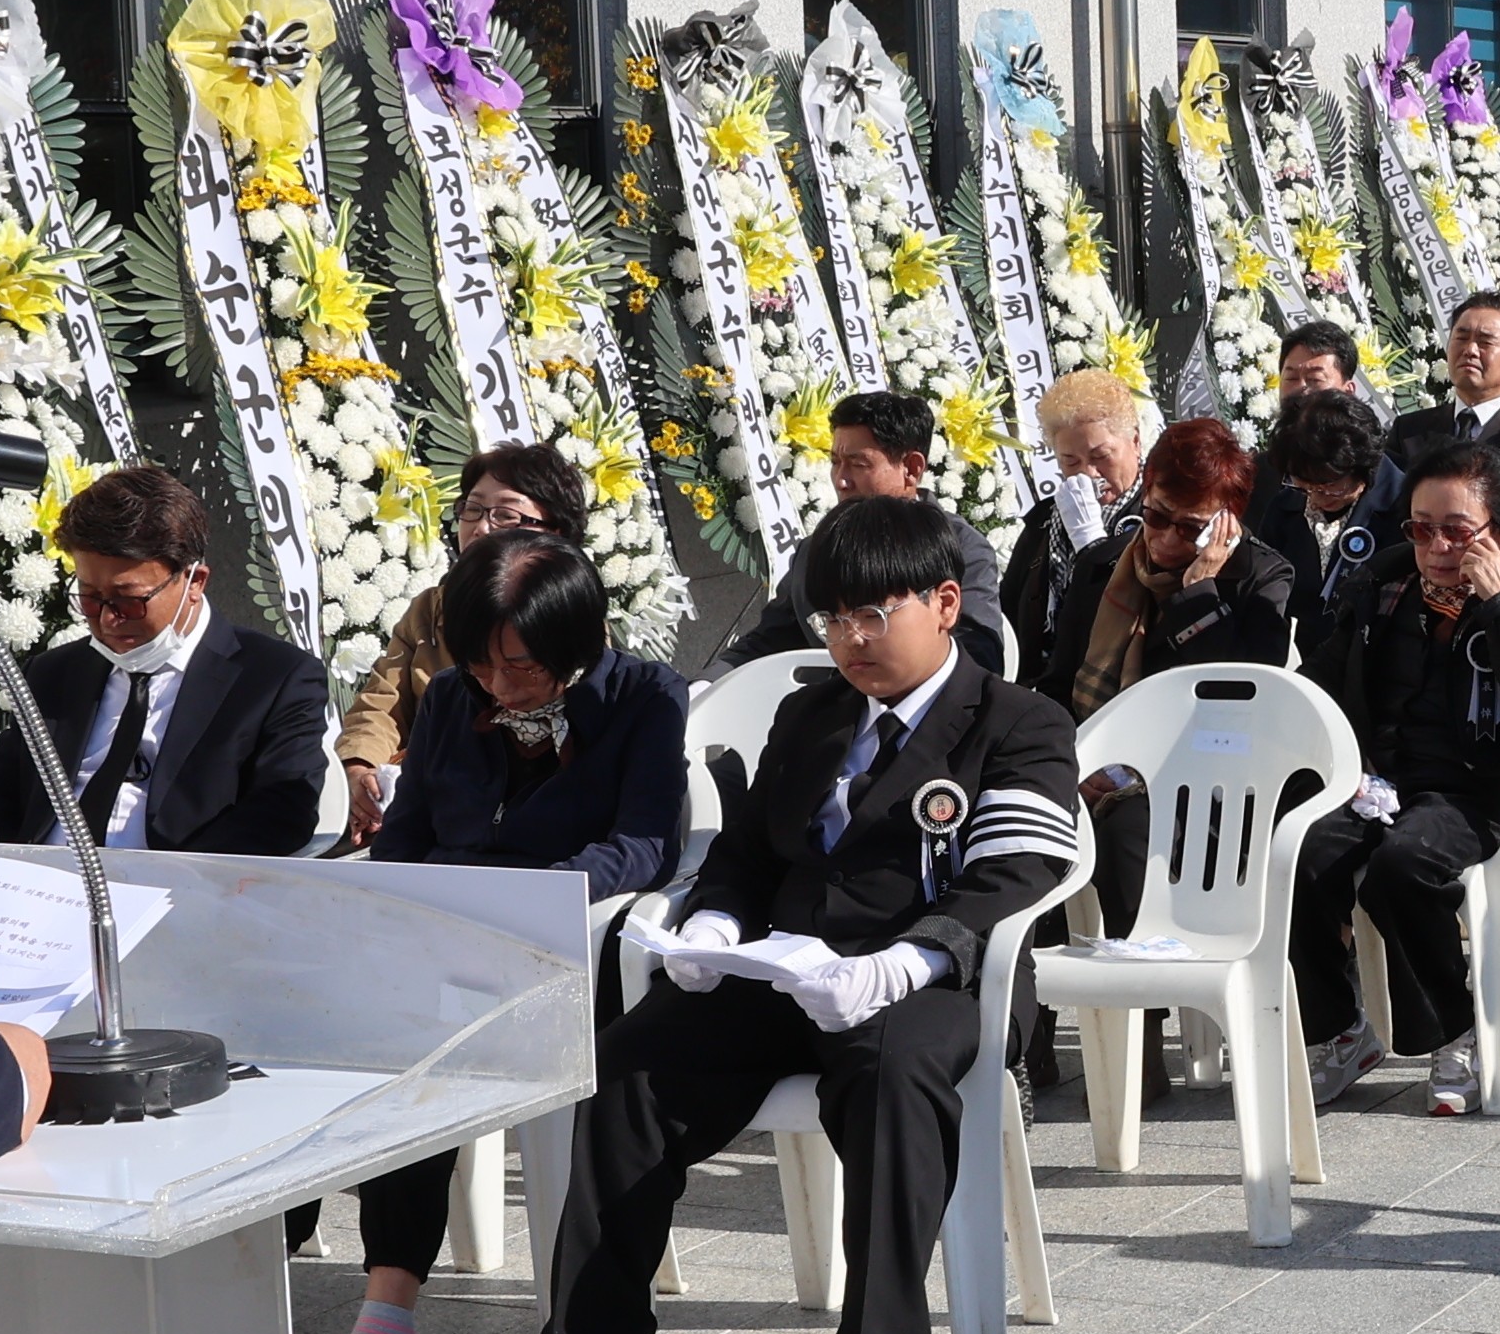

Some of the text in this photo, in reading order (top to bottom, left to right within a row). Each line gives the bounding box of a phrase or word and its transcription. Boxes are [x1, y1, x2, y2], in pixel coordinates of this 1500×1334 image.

[13, 121, 56, 201] 삼가
[422, 124, 494, 319] 보성군수
[676, 112, 747, 364] 신안군수
[983, 138, 1035, 327] 여수시의회
[24, 888, 90, 908] 의회운영위원
